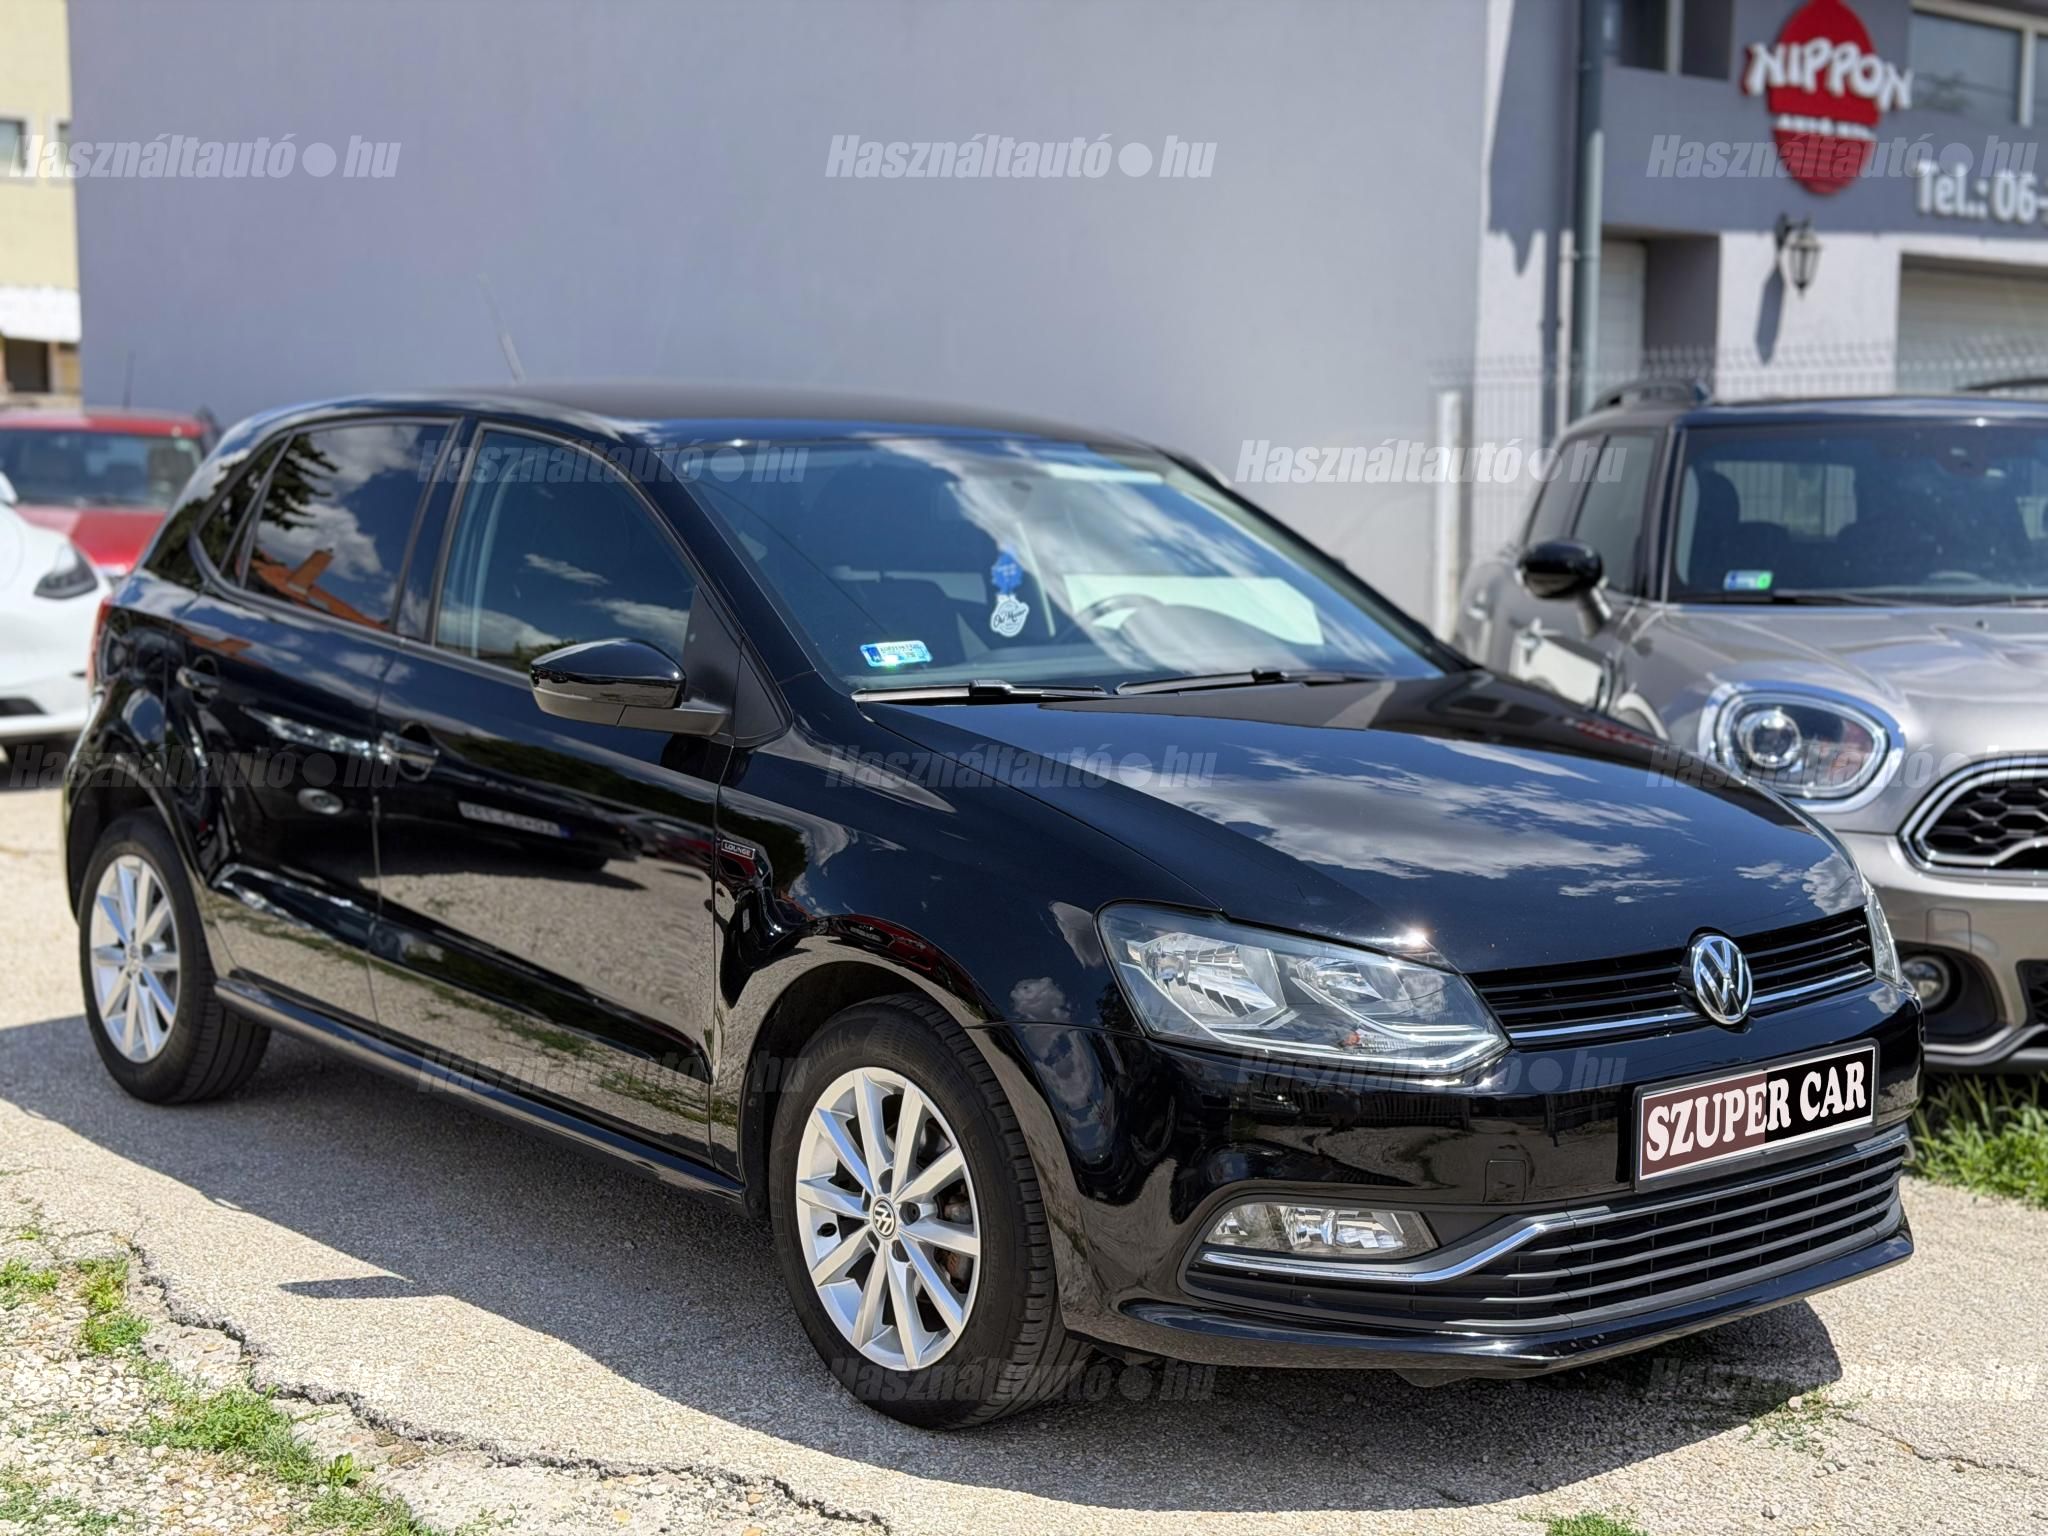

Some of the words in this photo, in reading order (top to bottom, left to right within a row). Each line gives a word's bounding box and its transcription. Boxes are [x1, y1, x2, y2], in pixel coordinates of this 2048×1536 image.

[1746, 37, 1914, 110] NIPPON
[1916, 158, 1988, 219] Tel.:
[1992, 168, 2048, 225] 06-
[724, 843, 751, 856] LOUNGE
[1646, 1073, 1791, 1163] SZUPER
[1799, 1060, 1867, 1123] CAR
